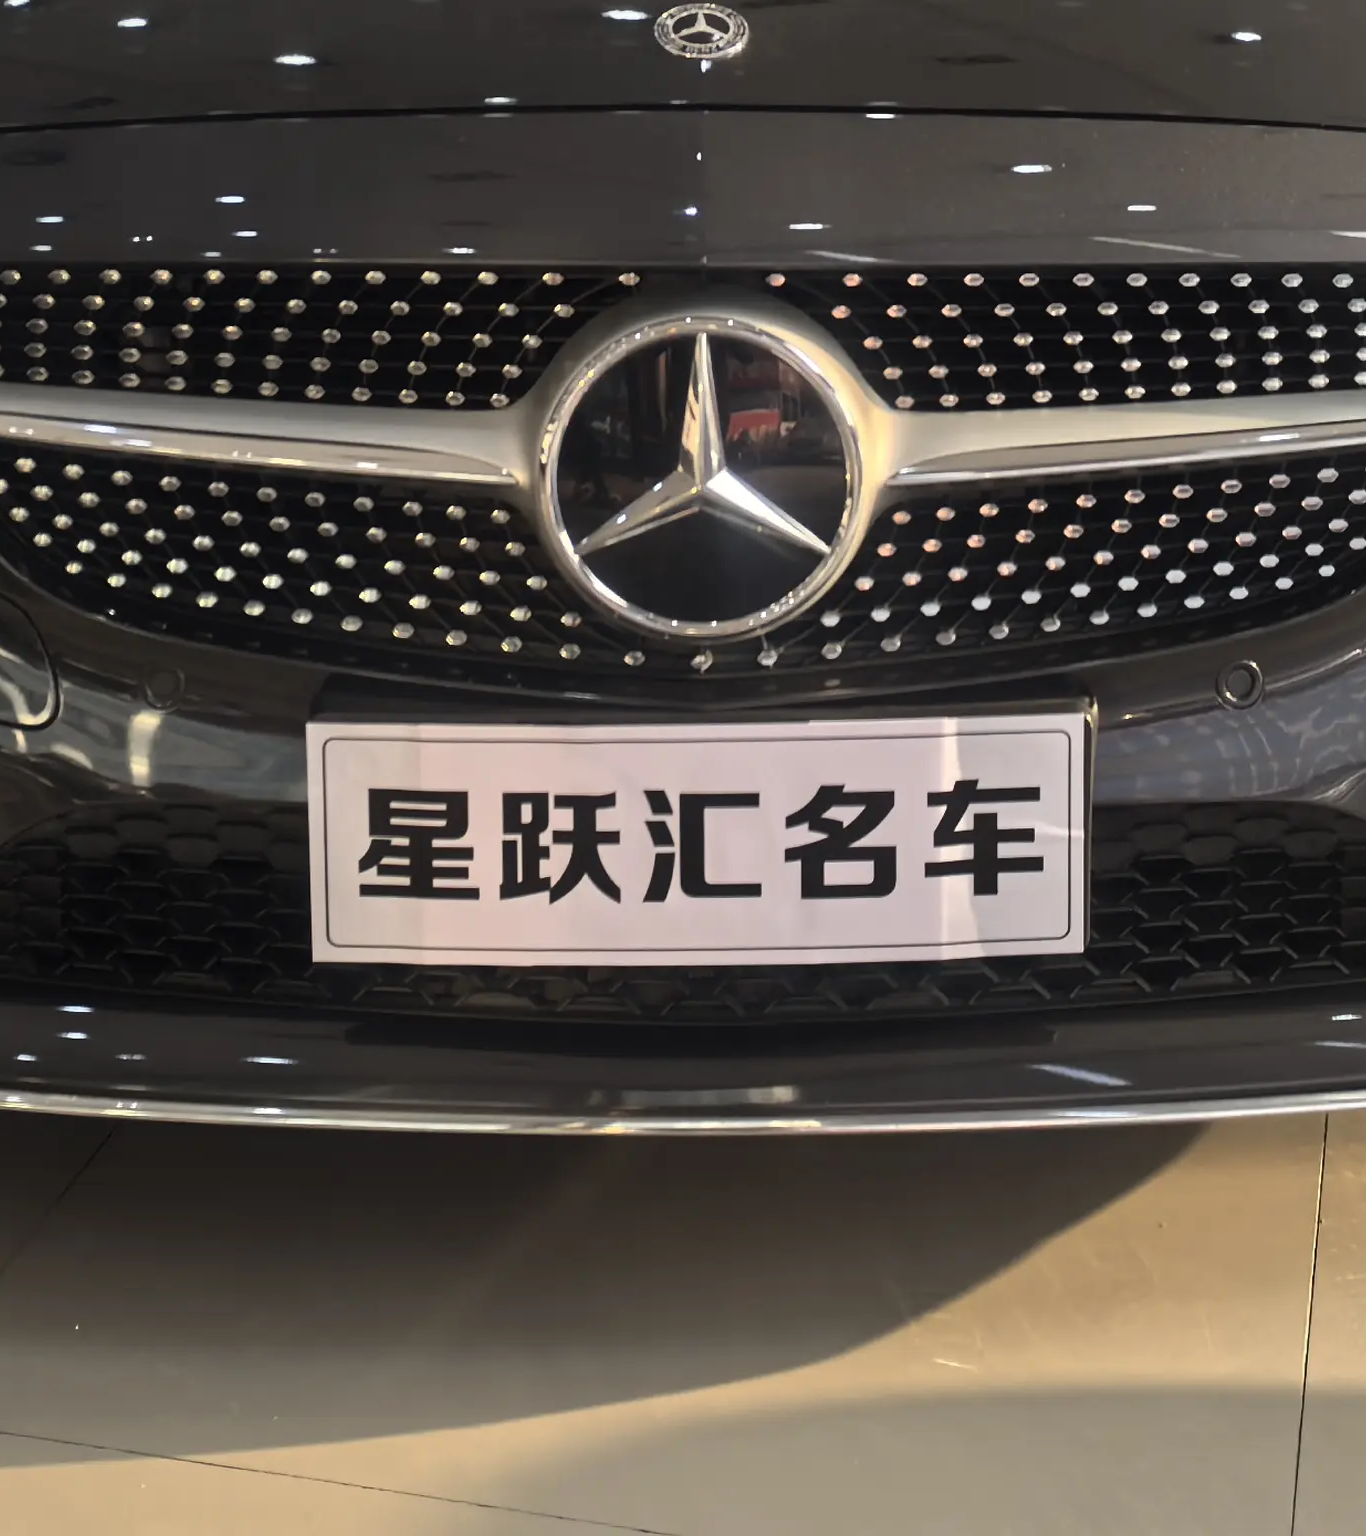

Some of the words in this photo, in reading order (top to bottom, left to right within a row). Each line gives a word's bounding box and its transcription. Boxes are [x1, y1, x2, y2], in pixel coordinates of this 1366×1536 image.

[357, 778, 1045, 906] 星跃汇名车
